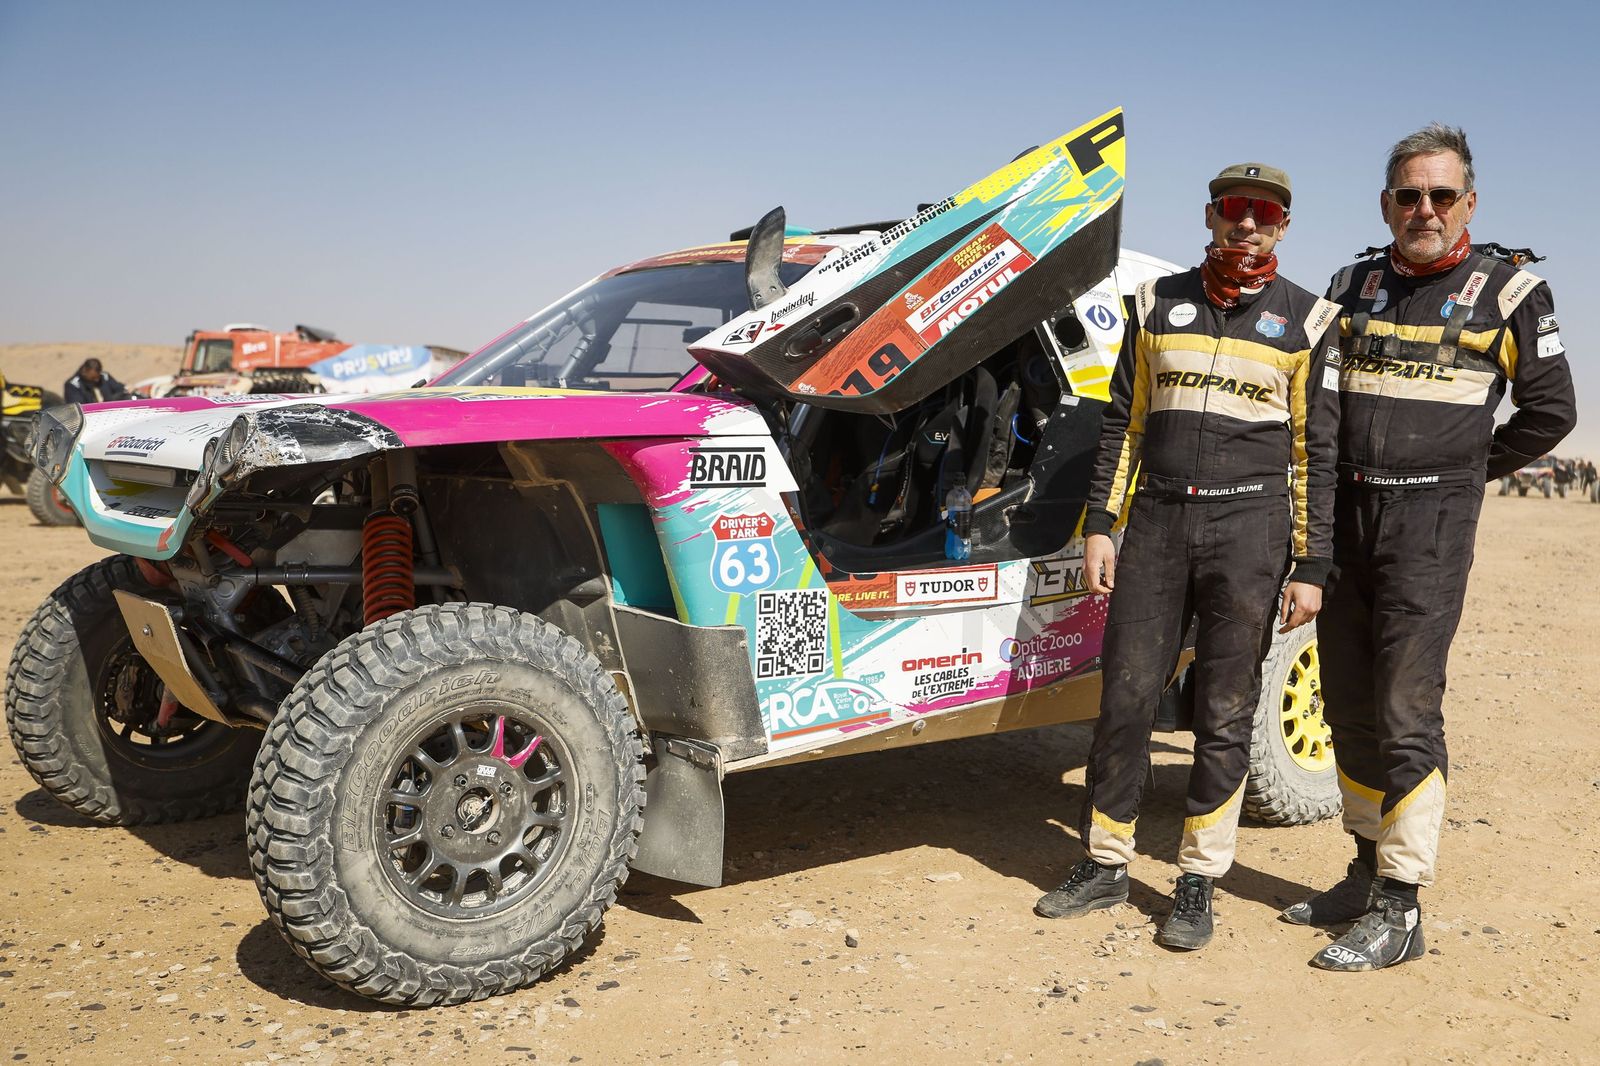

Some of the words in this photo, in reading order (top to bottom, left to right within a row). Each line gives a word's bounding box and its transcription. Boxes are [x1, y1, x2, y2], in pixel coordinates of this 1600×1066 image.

[1065, 112, 1125, 176] P
[819, 240, 875, 274] MAXIME
[879, 196, 955, 239] GUILLAUME
[835, 245, 879, 272] HERVE
[882, 200, 958, 245] GUILLAUME
[953, 233, 990, 262] DREAM.
[955, 244, 986, 266] DARE.
[961, 251, 983, 270] LIVE
[982, 243, 995, 256] IT.
[920, 250, 1006, 320] BFGoodrich
[1463, 275, 1484, 303] SIMPSON
[1507, 277, 1533, 304] MARINA
[938, 267, 1021, 336] MOTUL
[1312, 305, 1333, 331] MARINA
[827, 343, 912, 396] 19
[1156, 371, 1274, 403] PROPARC
[690, 454, 766, 481] BRAID
[1363, 475, 1440, 485] H.GUILLAUME
[1198, 484, 1263, 496] M.GUILLAUME
[720, 517, 768, 530] DRIVER'S
[730, 527, 759, 539] PARK
[720, 543, 771, 587] 63
[855, 591, 877, 601] LIVE
[878, 590, 890, 600] IT.
[920, 579, 974, 594] TUDOR
[1050, 632, 1083, 650] 2000
[901, 648, 982, 672] omerin
[914, 673, 932, 686] LES
[933, 667, 969, 683] CABLES
[769, 684, 840, 731] RCA
[912, 689, 922, 699] DE
[341, 669, 499, 853] BFGoodrich
